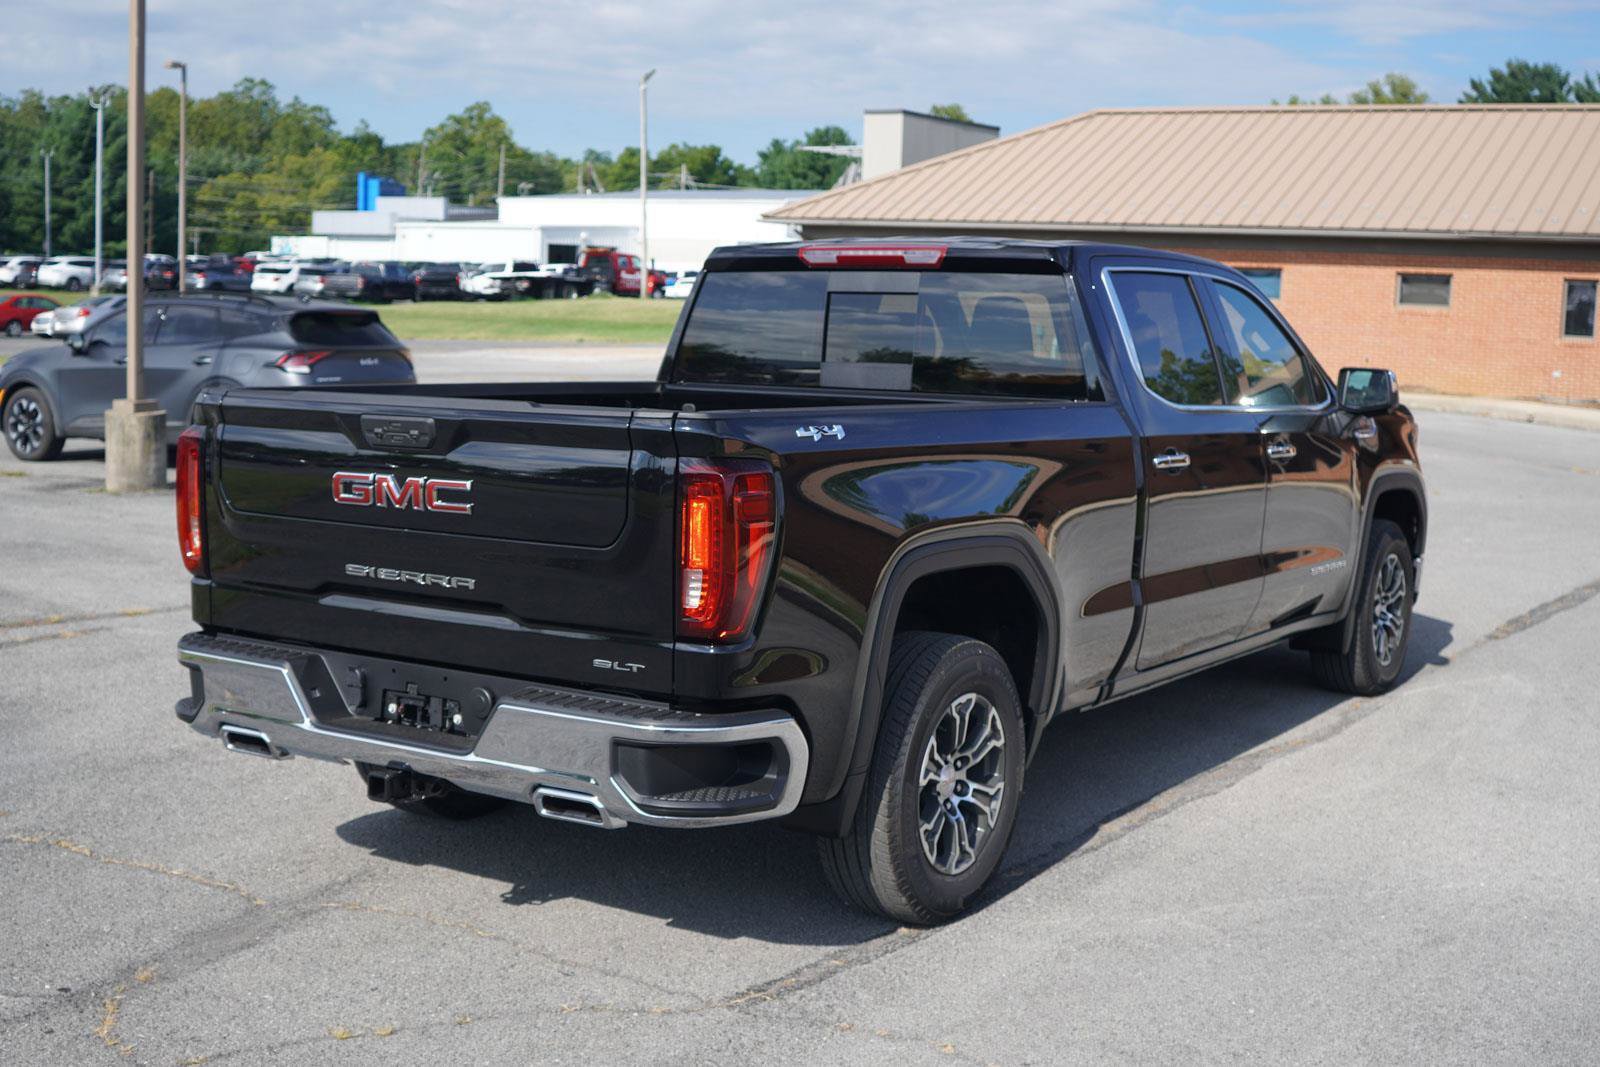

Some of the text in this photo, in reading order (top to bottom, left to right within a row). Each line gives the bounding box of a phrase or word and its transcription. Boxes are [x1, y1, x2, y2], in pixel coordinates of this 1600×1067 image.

[332, 471, 474, 515] GMC
[345, 563, 476, 590] SIERRA
[592, 658, 646, 673] SLT
